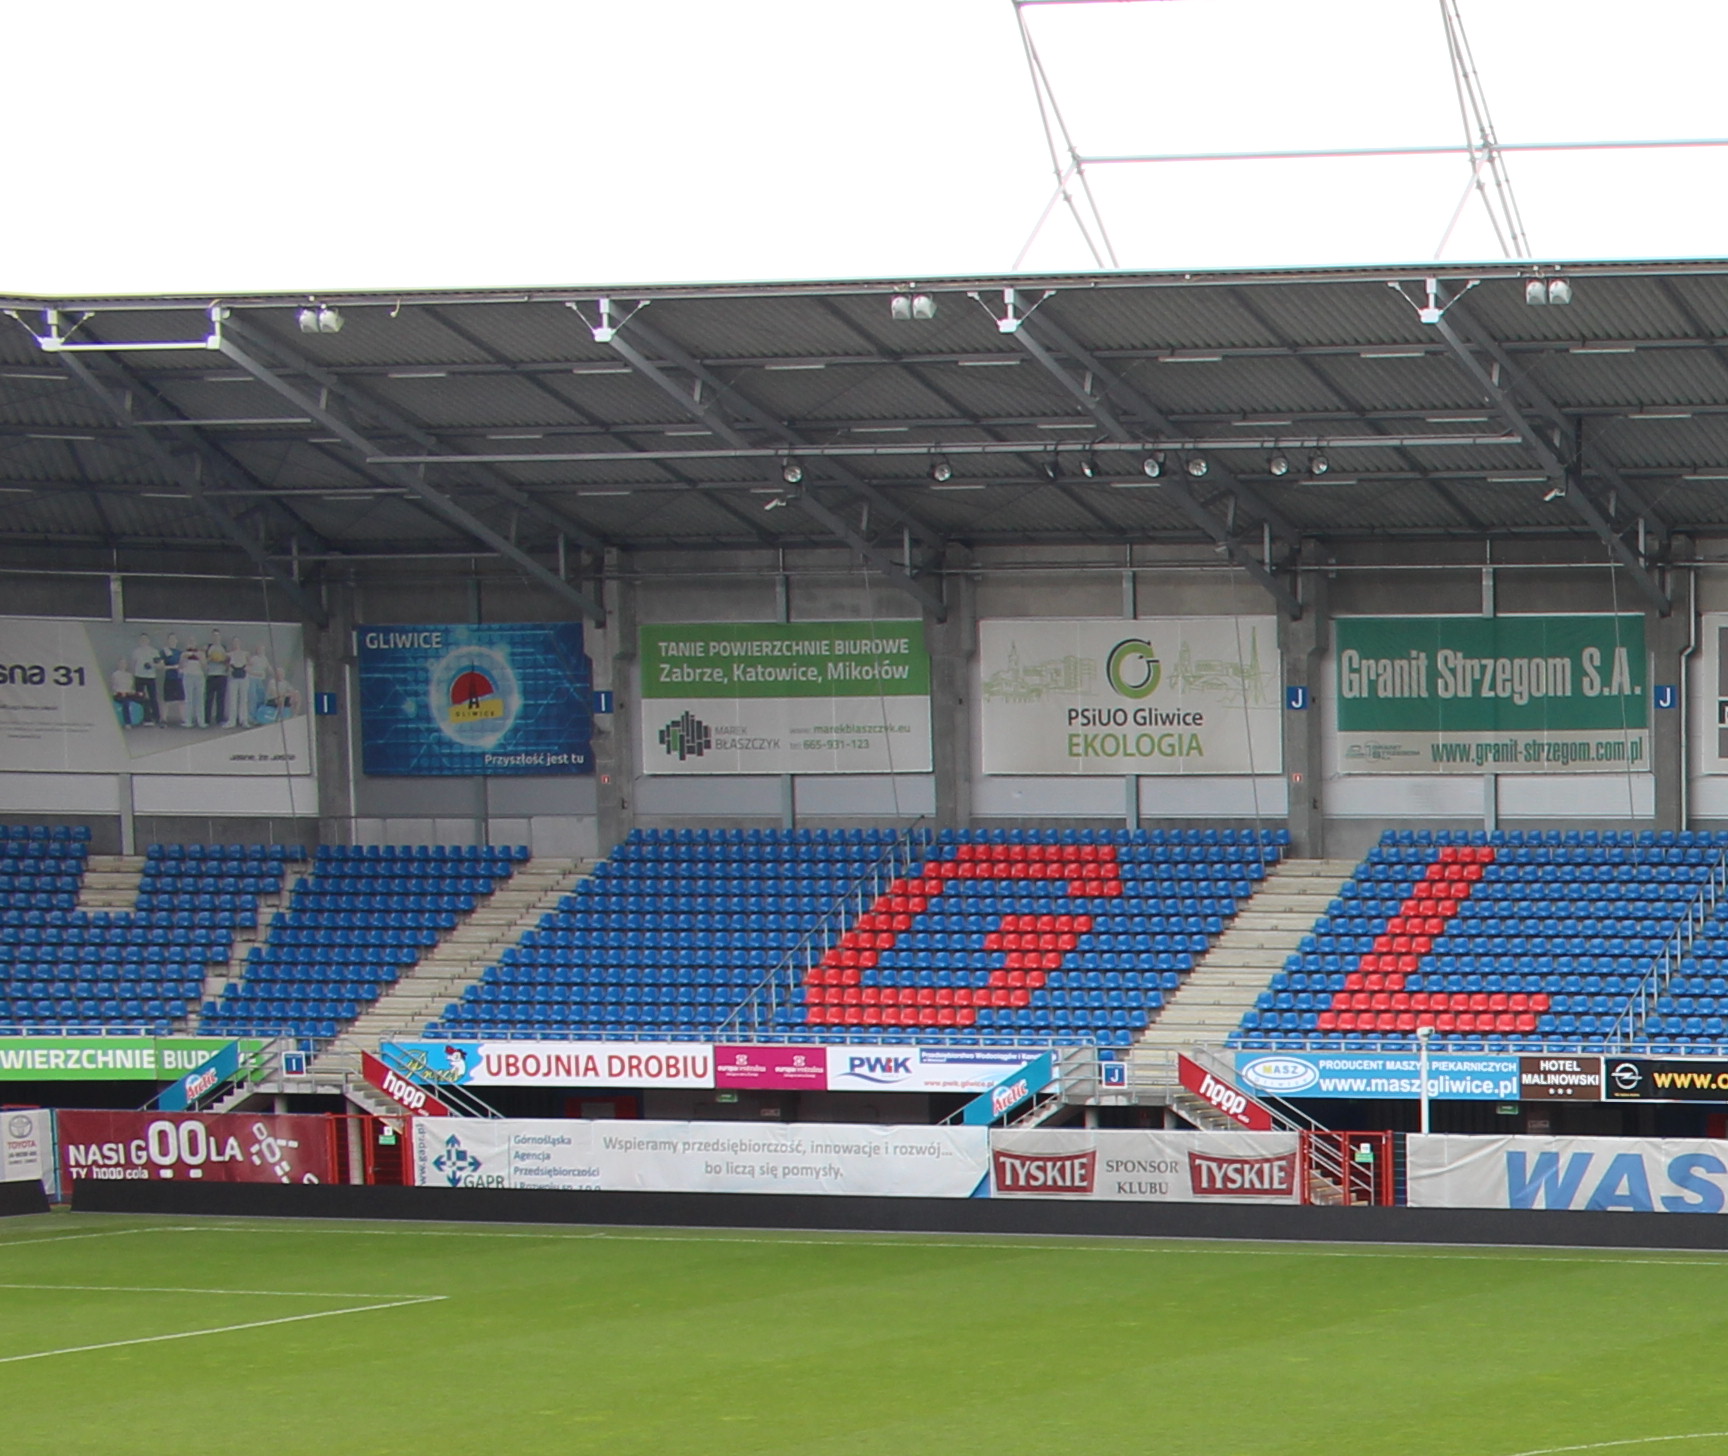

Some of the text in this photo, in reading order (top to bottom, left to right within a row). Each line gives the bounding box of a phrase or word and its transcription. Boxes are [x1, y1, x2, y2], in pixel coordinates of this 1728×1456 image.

[366, 632, 442, 650] GLIWICE
[658, 639, 909, 657] TANIE POWIERZCHNIE BIUROWE
[53, 666, 86, 687] 31
[660, 662, 909, 685] Zabrze, Katowice, Mikołów
[1341, 647, 1641, 705] Granit Strzegom S.A.
[1068, 707, 1203, 727] PSiUO Gliwice
[715, 726, 747, 735] MAREK
[715, 738, 780, 750] BŁASZCZYK
[803, 739, 869, 750] 665-931-123
[1068, 733, 1204, 757] EKOLOGIA
[1431, 737, 1643, 767] www.granit-strzegom.com.pl
[485, 753, 584, 767] Przyszłość jest tu
[485, 1054, 709, 1079] UBOJNIA DROBIU
[1263, 1065, 1299, 1073] MASZ
[1320, 1060, 1516, 1072] PRODUCENT MASZY PIEKARNICZYCH
[1540, 1060, 1580, 1072] HOTEL
[1522, 1074, 1599, 1086] MALINOWSKI
[514, 1135, 572, 1145] Górnośląska
[603, 1137, 890, 1157] Wspieramy przedsiębiorczość, innowacje i
[69, 1143, 124, 1166] NASI
[514, 1151, 551, 1161] Agencja
[514, 1167, 600, 1177] Przedsiębiorczości
[705, 1162, 843, 1181] bo liczą się pomysły.
[1000, 1157, 1086, 1187] TYSKIE
[1106, 1160, 1179, 1173] SPONSOR
[1195, 1159, 1288, 1190] TYSKIE
[464, 1175, 505, 1188] GAPR
[1117, 1181, 1169, 1195] KLUBU
